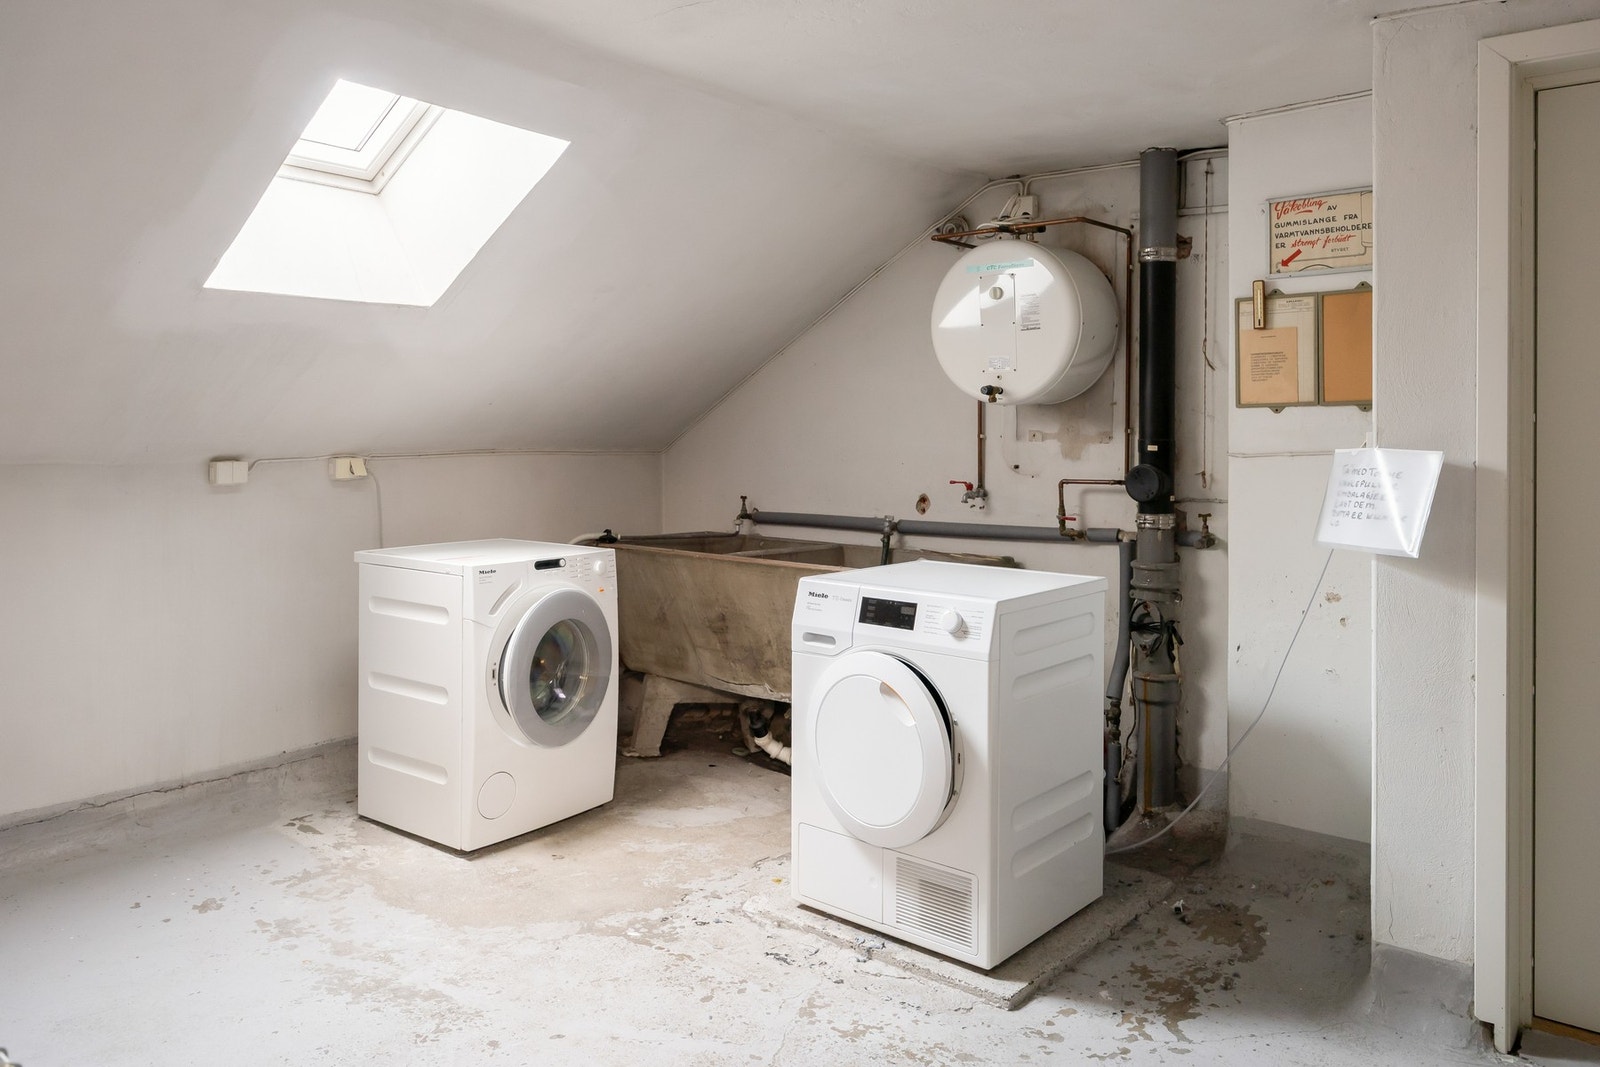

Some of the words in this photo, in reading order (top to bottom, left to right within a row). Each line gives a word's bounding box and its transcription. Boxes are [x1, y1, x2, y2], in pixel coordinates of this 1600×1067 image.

[1274, 216, 1337, 229] GUMMISLANGE
[1343, 213, 1358, 221] FRA
[1291, 237, 1321, 249] strengt
[807, 591, 829, 600] Miele
